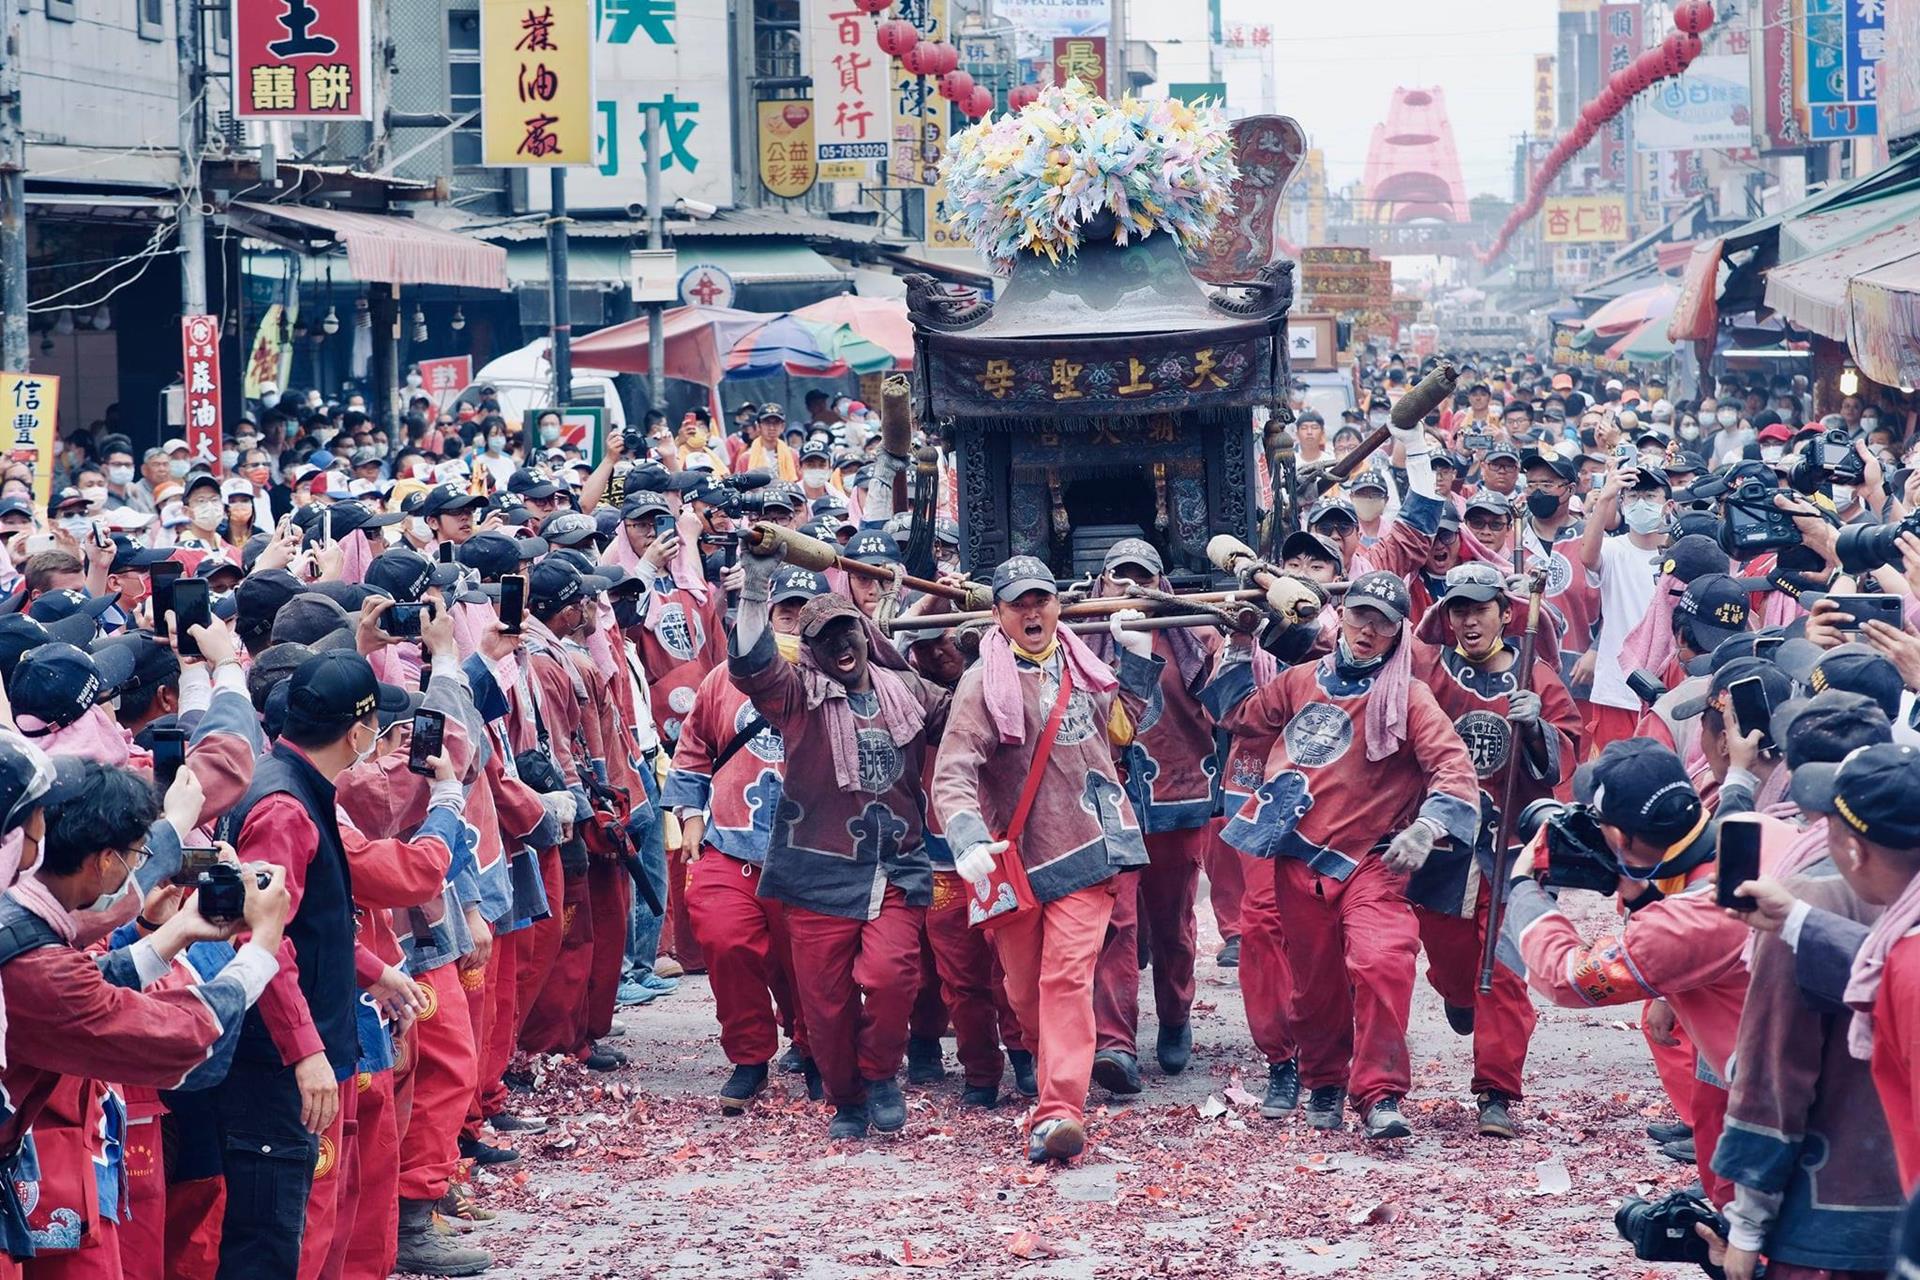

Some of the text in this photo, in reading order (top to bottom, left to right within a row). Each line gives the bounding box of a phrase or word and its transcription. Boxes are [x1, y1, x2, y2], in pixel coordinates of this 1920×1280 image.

[829, 10, 874, 140] 百貨行
[767, 141, 808, 162] 公益
[820, 144, 887, 159] 05-7833029
[767, 164, 809, 186] 彩券
[1547, 205, 1624, 236] 杏仁粉
[976, 347, 1231, 401] 天上聖母
[13, 380, 42, 474] 信豐
